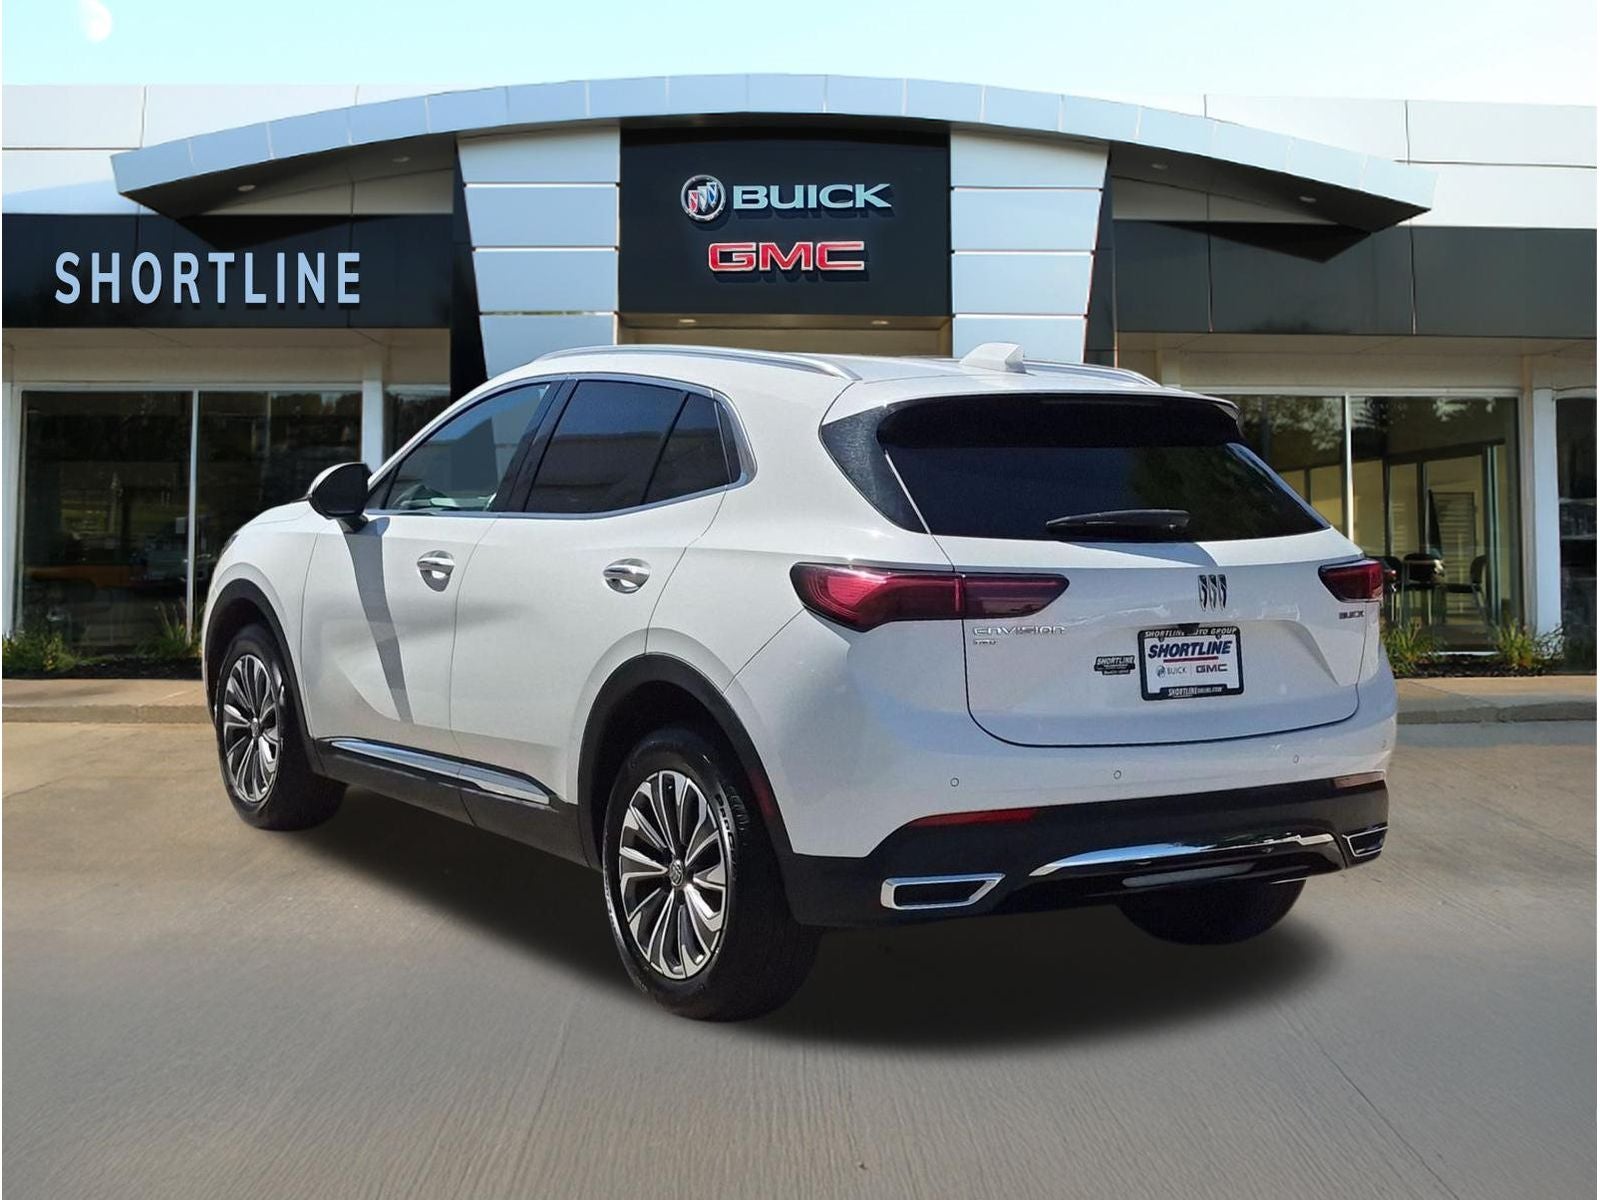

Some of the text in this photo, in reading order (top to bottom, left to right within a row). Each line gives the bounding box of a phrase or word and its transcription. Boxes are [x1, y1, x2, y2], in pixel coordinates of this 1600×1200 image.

[733, 183, 892, 209] BUICK
[708, 241, 865, 271] GMC
[55, 251, 360, 304] SHORTLINE
[1210, 626, 1237, 635] GROUP
[1148, 640, 1232, 659] SHORTLINE
[1196, 663, 1228, 673] GMC
